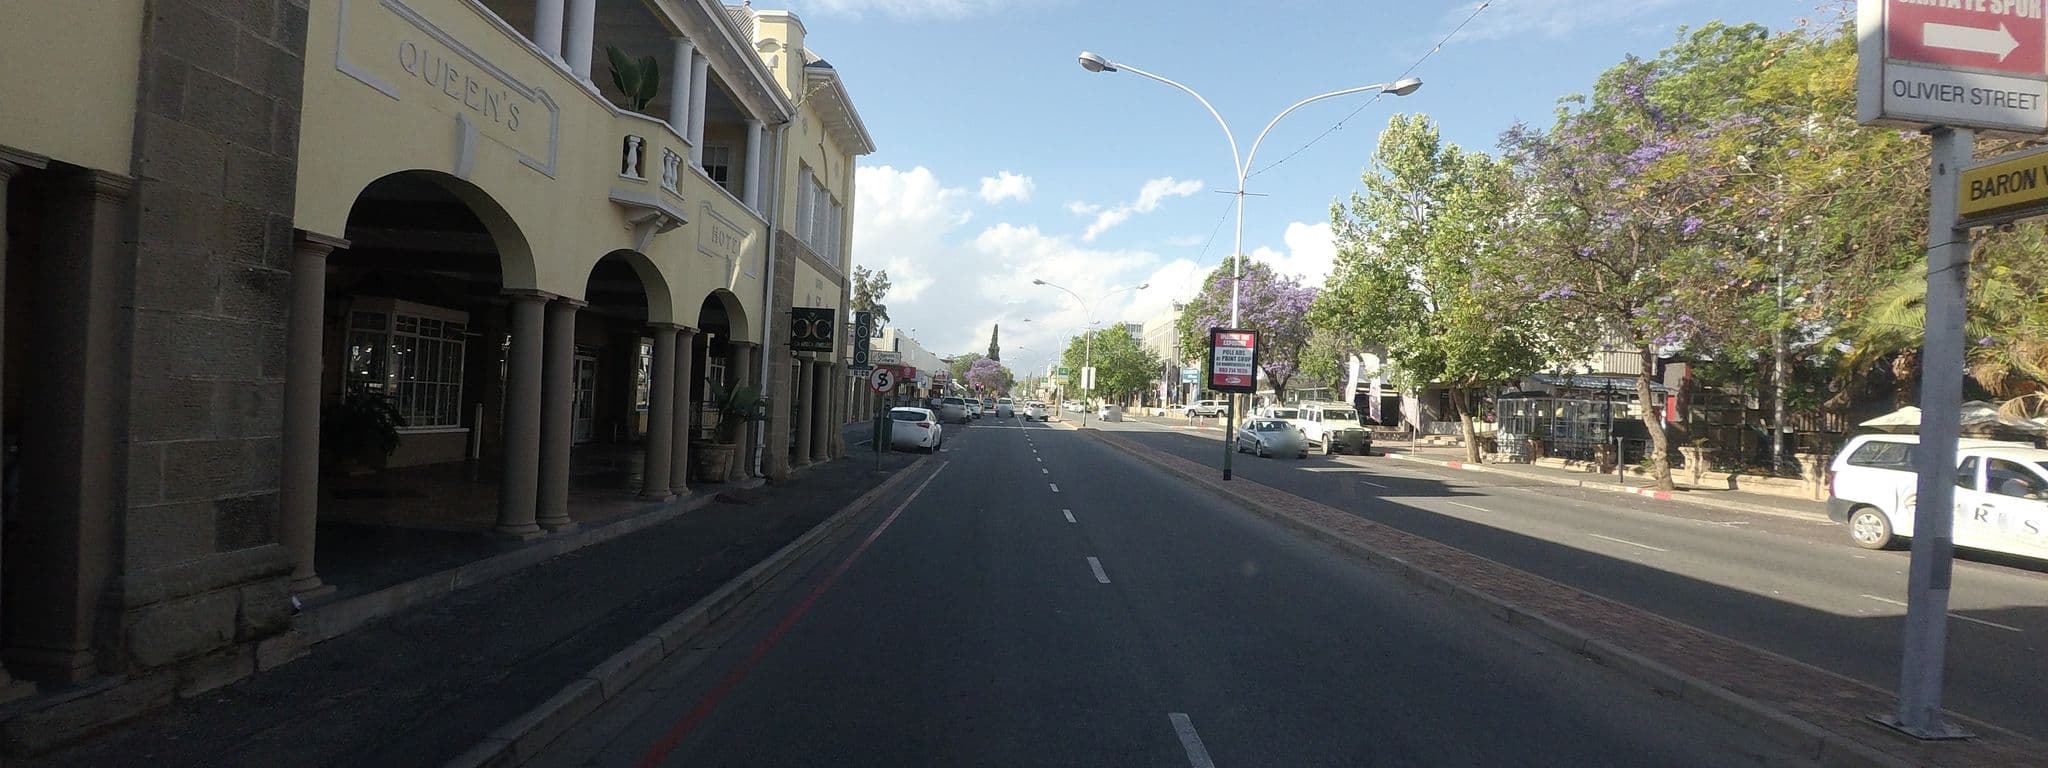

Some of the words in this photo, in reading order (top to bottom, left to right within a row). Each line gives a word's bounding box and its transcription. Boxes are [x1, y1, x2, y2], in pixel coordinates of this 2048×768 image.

[1990, 0, 2042, 19] SPUR
[399, 39, 521, 132] QUEEN'S
[1892, 79, 1965, 103] OLIVIER
[1970, 87, 2041, 111] STREET
[1970, 167, 2038, 202] BARON
[856, 313, 869, 364] COCO
